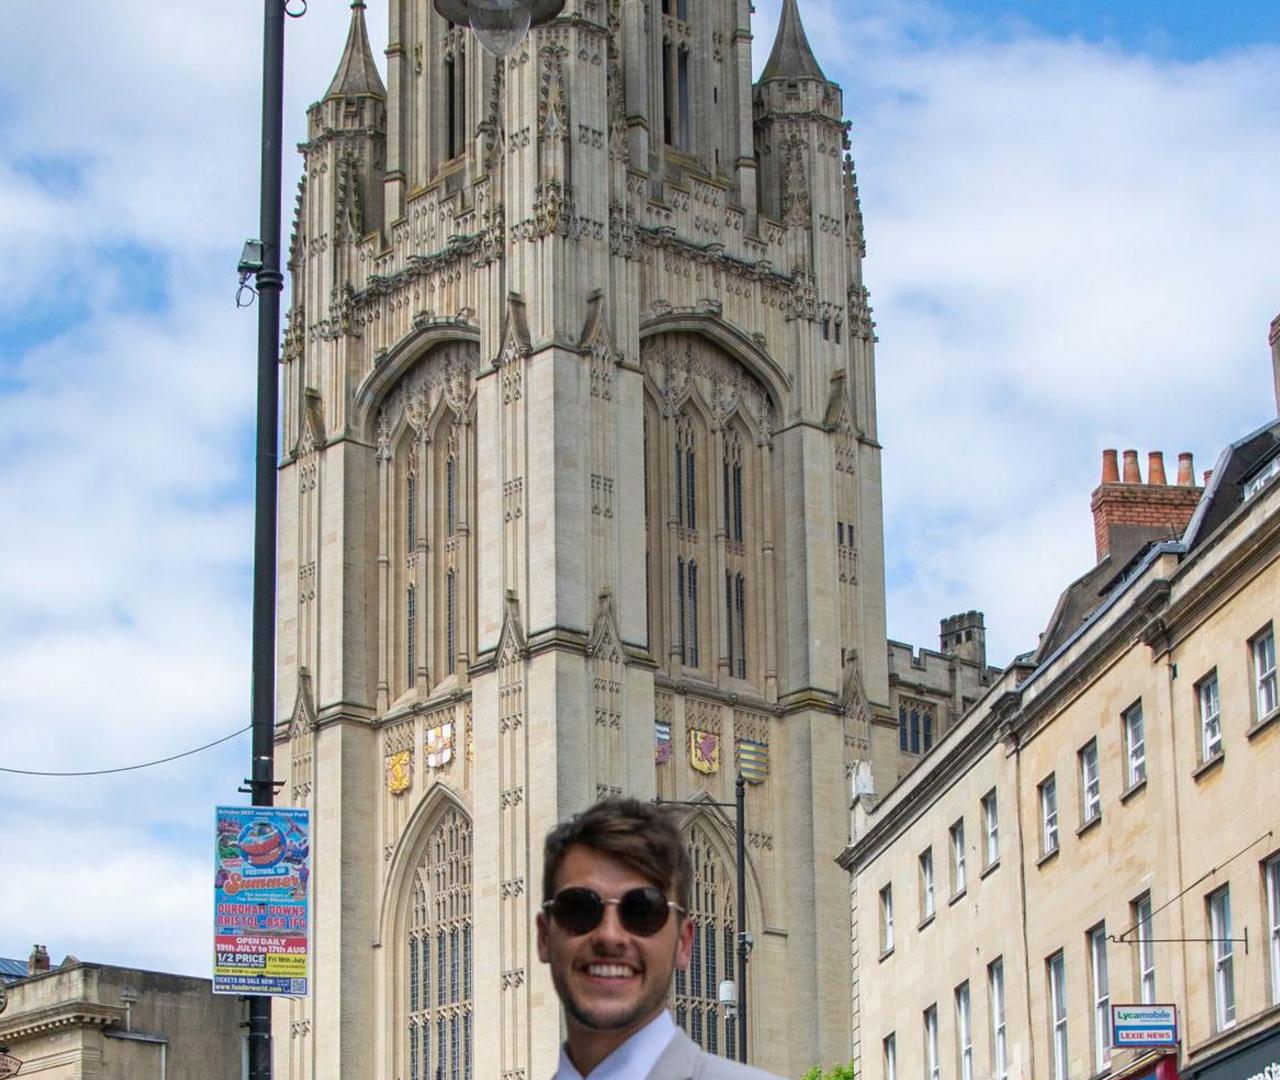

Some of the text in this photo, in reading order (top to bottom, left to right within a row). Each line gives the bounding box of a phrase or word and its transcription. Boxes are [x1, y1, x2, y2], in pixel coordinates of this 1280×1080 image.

[223, 873, 299, 895] Summer
[218, 904, 305, 916] DURDHAM DOWNS
[217, 915, 258, 927] BRISTOL
[261, 938, 287, 946] DAILY
[217, 944, 235, 952] 19th
[236, 945, 257, 953] JULY
[258, 945, 267, 953] to
[269, 945, 286, 953] 17th
[217, 954, 265, 963] 1/2 PRICE
[1118, 1011, 1170, 1020] Lycamobile
[1120, 1032, 1145, 1040] LEXIE
